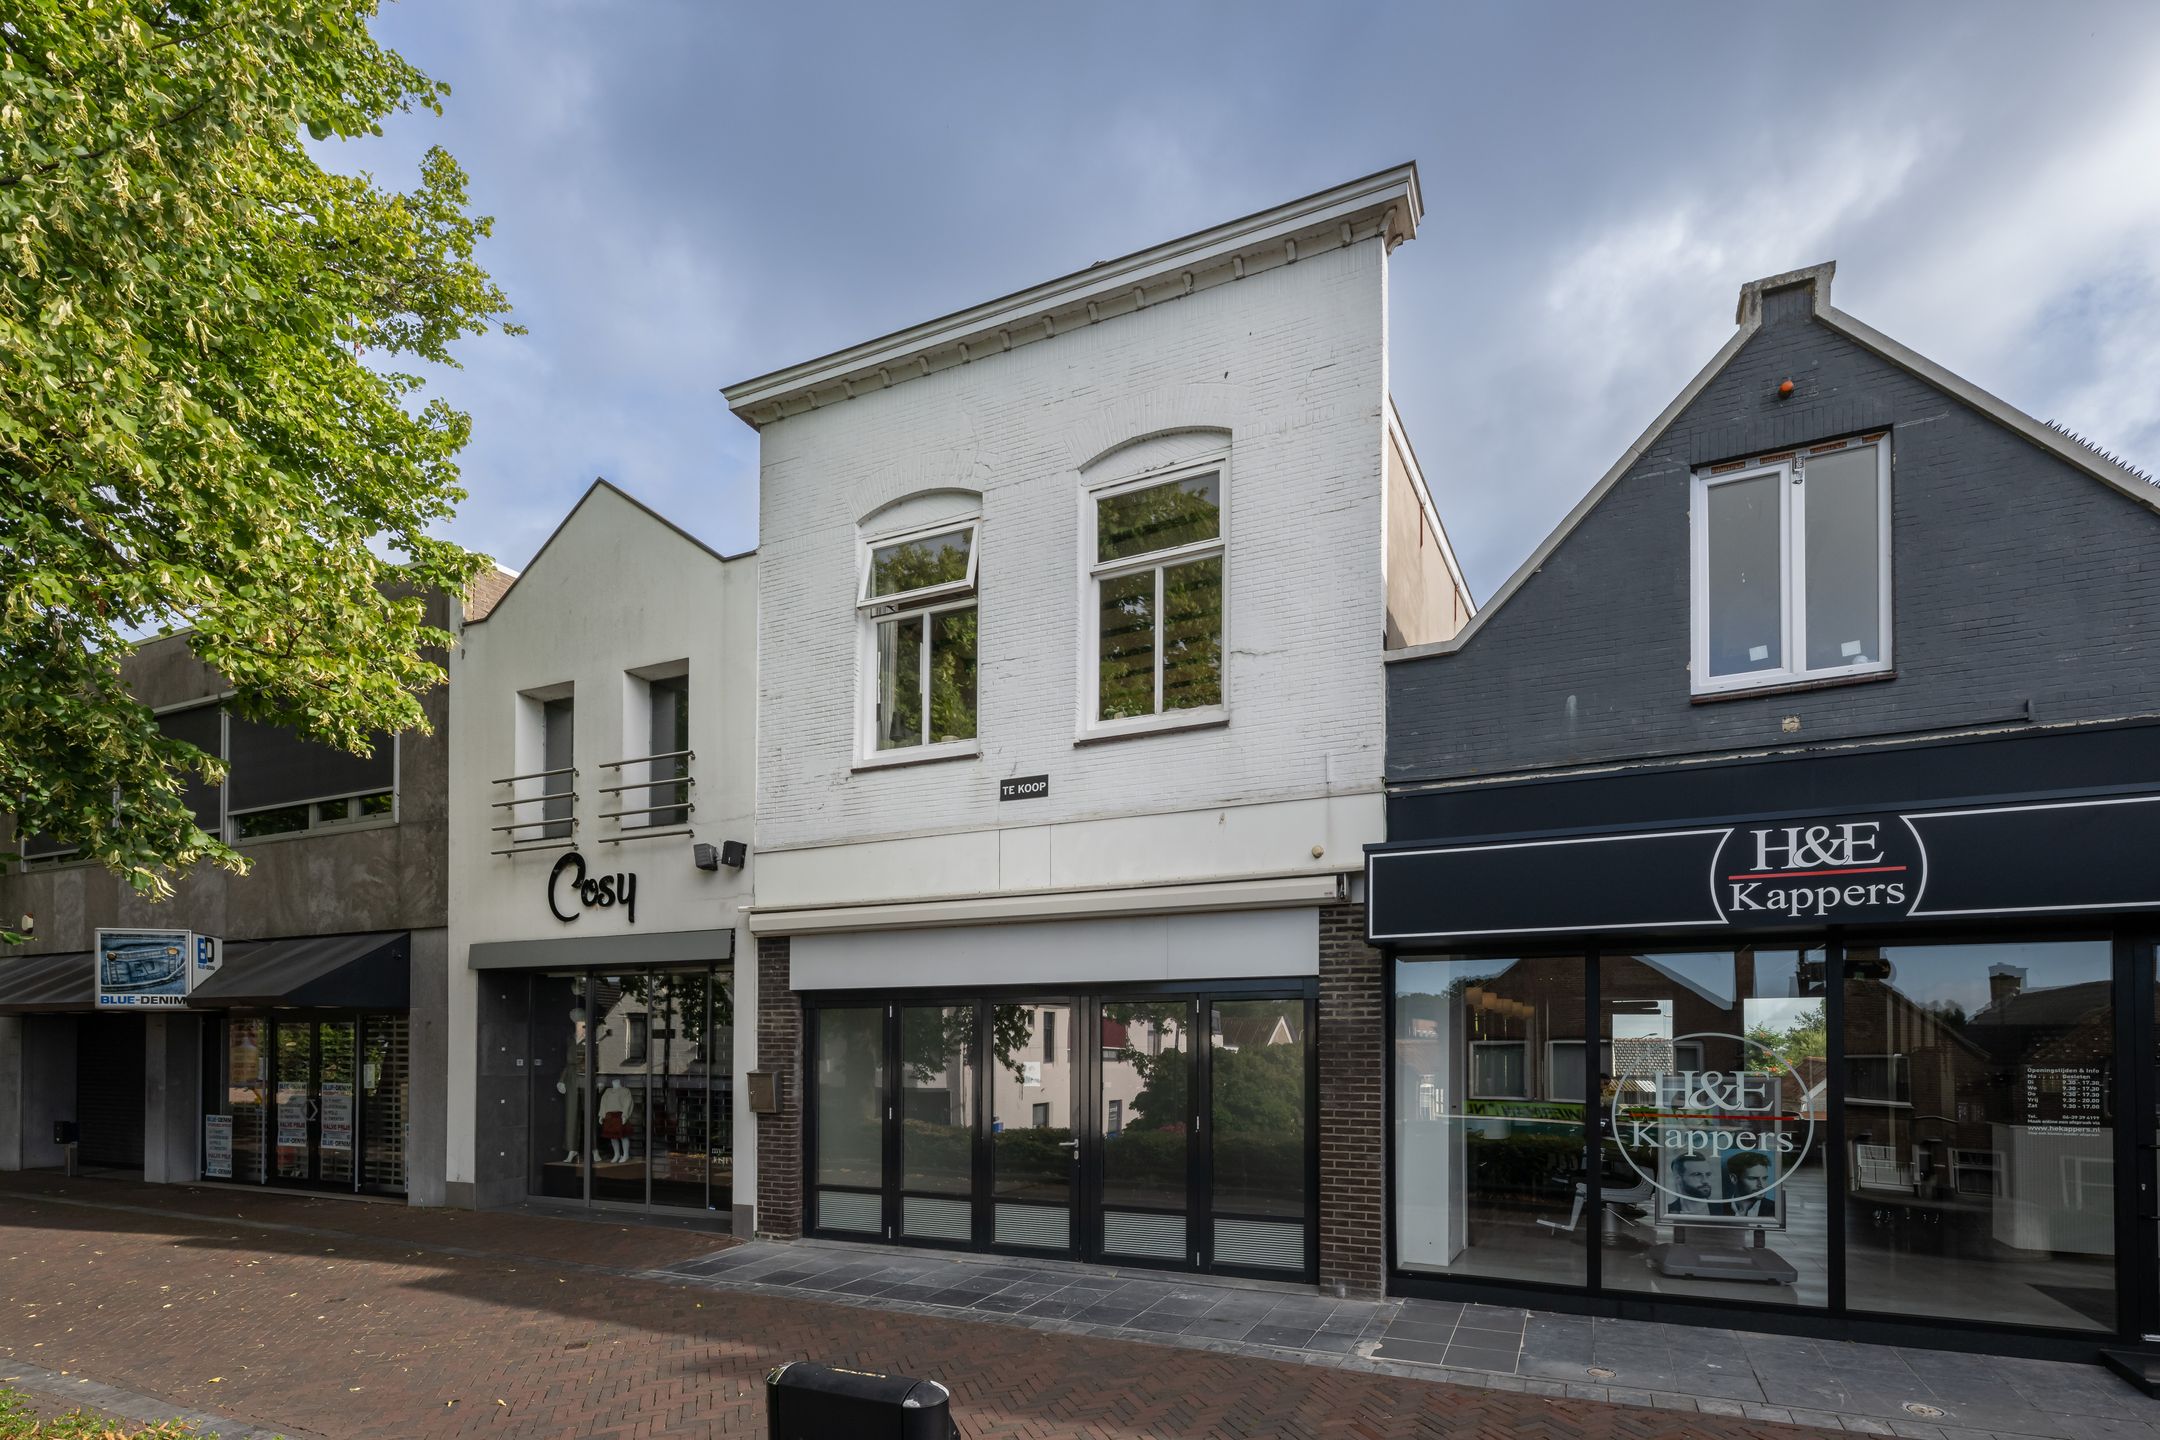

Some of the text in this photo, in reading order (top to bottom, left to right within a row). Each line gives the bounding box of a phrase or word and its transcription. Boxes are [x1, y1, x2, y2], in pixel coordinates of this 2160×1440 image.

[1002, 782, 1047, 795] TE KOOP
[1750, 821, 1884, 871] H&E
[548, 852, 637, 923] Cosy
[1728, 882, 1906, 917] Kappers
[100, 995, 186, 1005] BLUE-DENIM
[1649, 1070, 1775, 1112] H&E
[1629, 1120, 1795, 1157] Kappers
[2027, 1125, 2101, 1133] www.hekappers.nl
